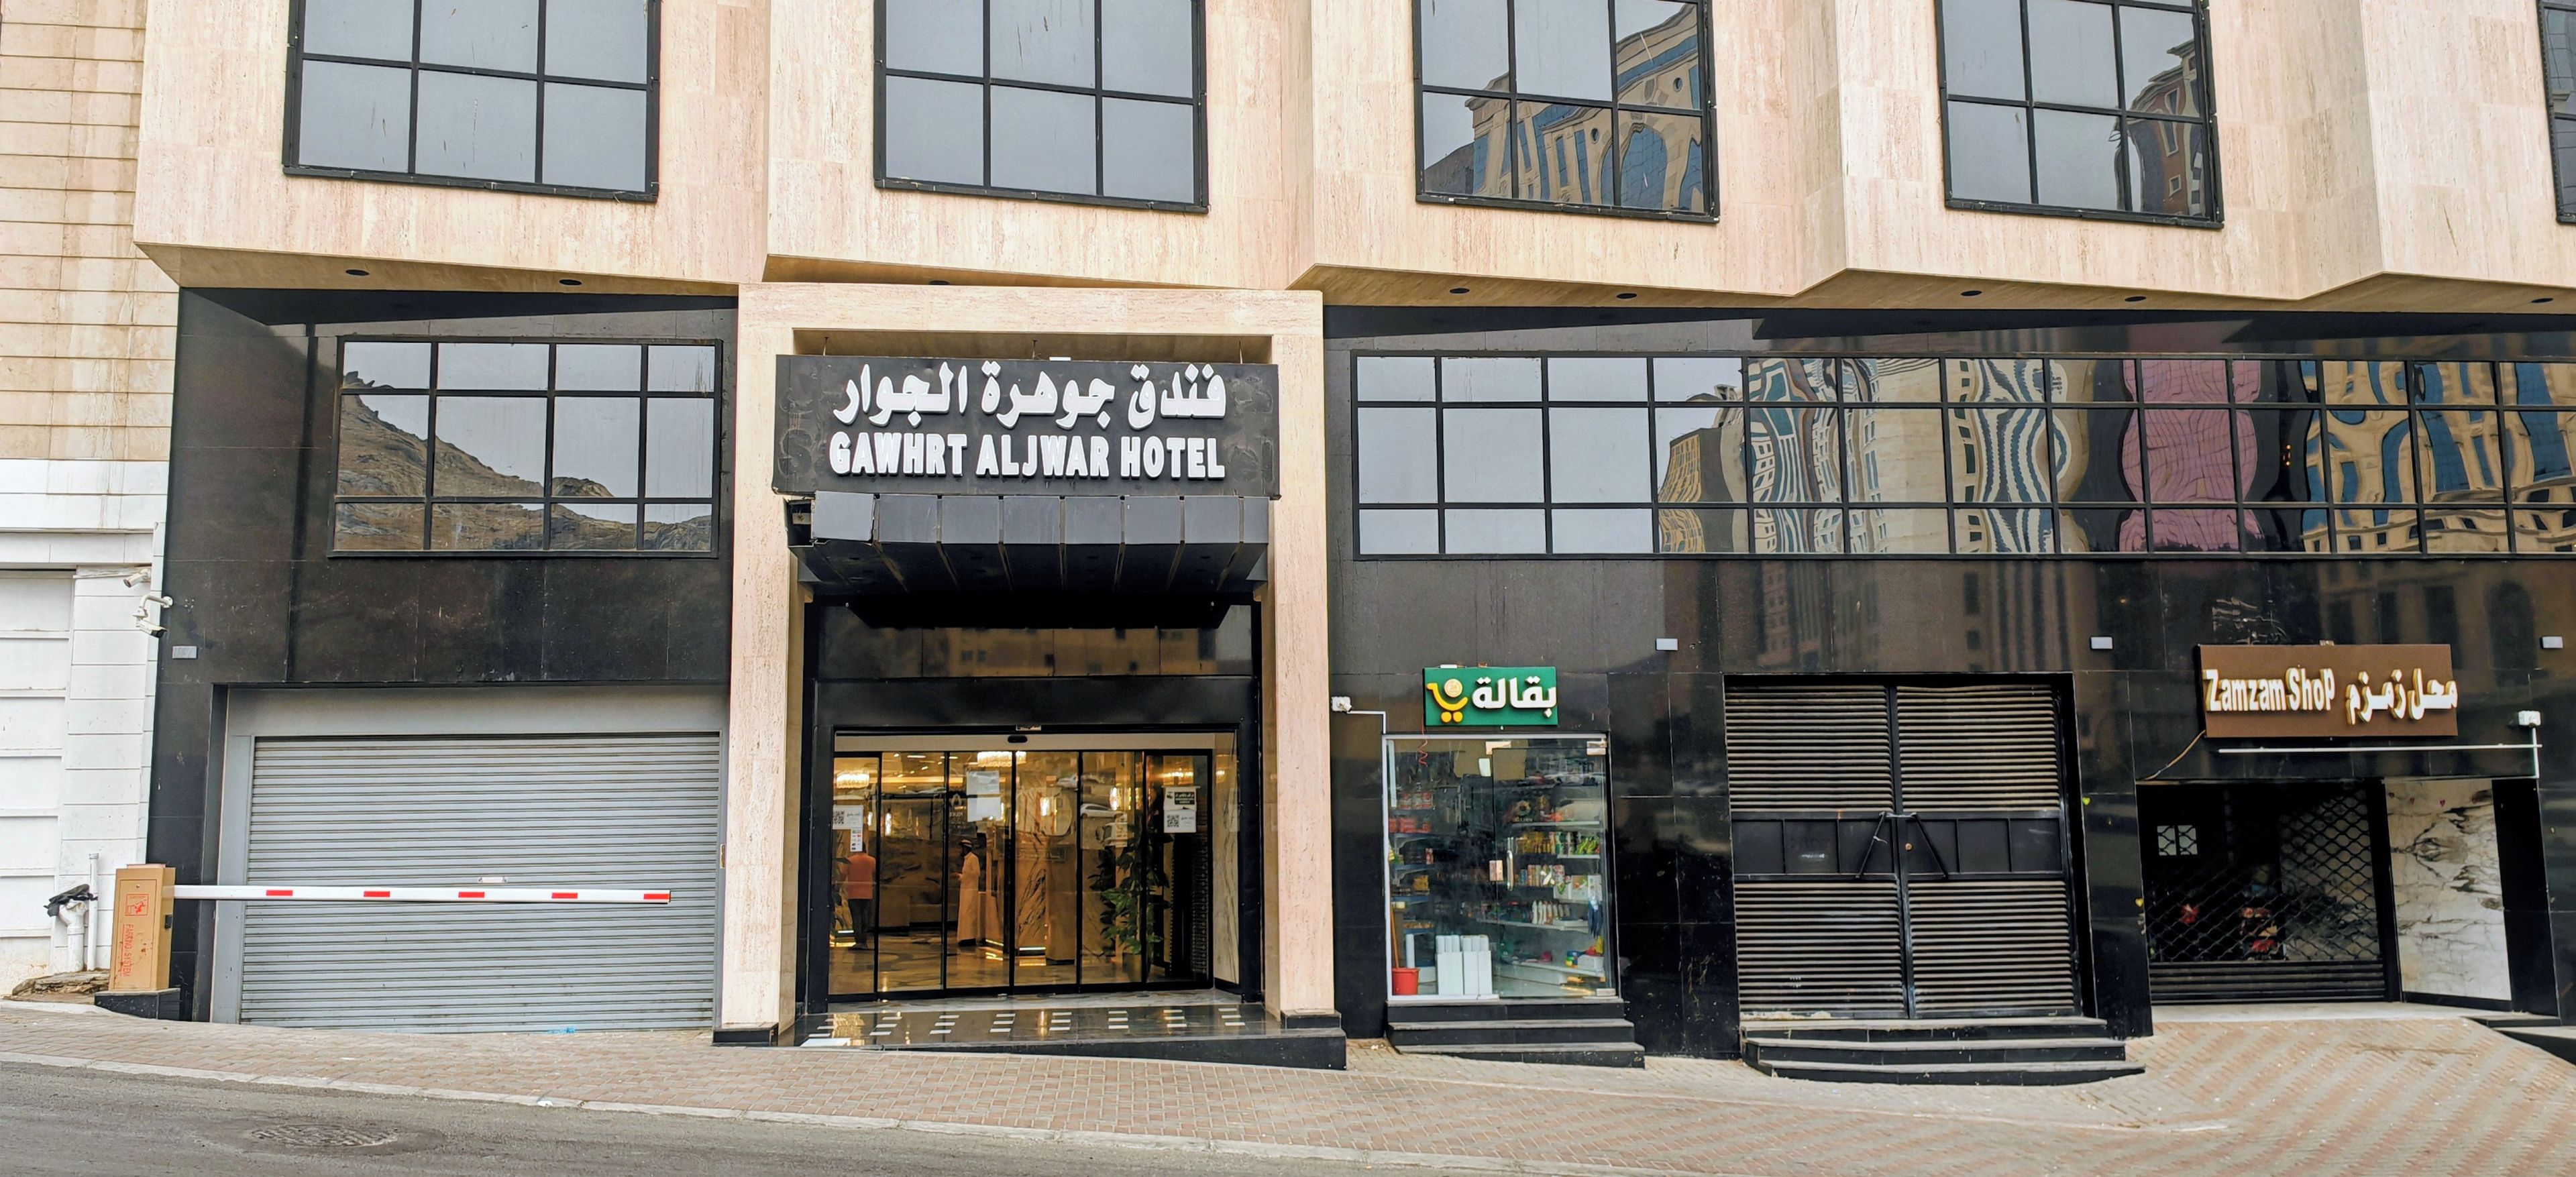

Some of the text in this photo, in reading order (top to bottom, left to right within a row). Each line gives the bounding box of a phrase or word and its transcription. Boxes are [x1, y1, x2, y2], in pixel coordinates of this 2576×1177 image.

[833, 360, 1226, 429] فندق جوهرة الجوار
[829, 432, 1226, 480] GAWHRT ALJWAR HOTEL
[1472, 675, 1557, 718] بقالة
[2202, 669, 2286, 712] Zamzam
[2345, 668, 2459, 725] محل زمزم
[123, 952, 132, 977] SYSTEM
